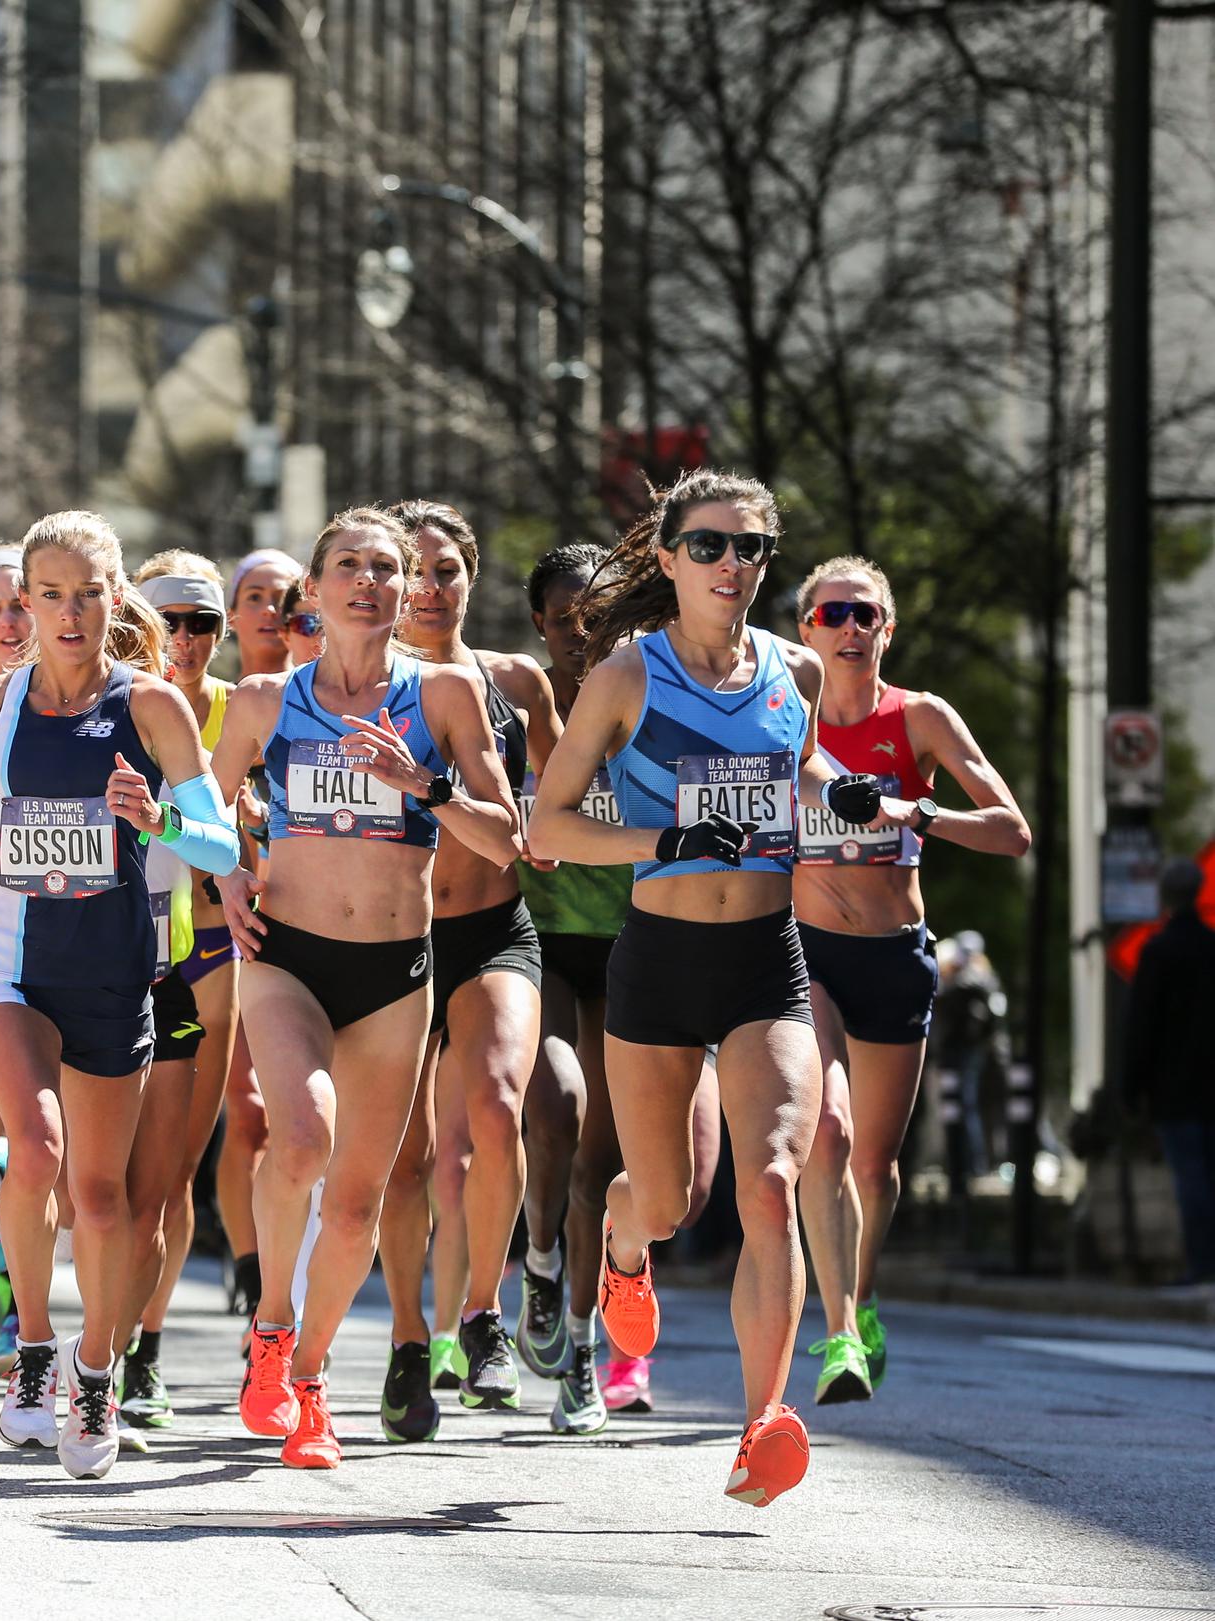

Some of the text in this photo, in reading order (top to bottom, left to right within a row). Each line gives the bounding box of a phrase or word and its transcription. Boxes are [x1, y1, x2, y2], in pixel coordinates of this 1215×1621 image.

[318, 743, 335, 755] U.S.
[317, 755, 341, 767] TEAM
[708, 756, 770, 770] U.S. OLYMPIC
[708, 768, 770, 783] TEAM TRIALS
[313, 769, 377, 806] HALL
[23, 801, 84, 813] U.S. OLYMPIC
[698, 783, 776, 822] BATES
[23, 813, 85, 825] TEAM TRIALS
[97, 808, 103, 817] 5
[9, 828, 103, 865] SISSON
